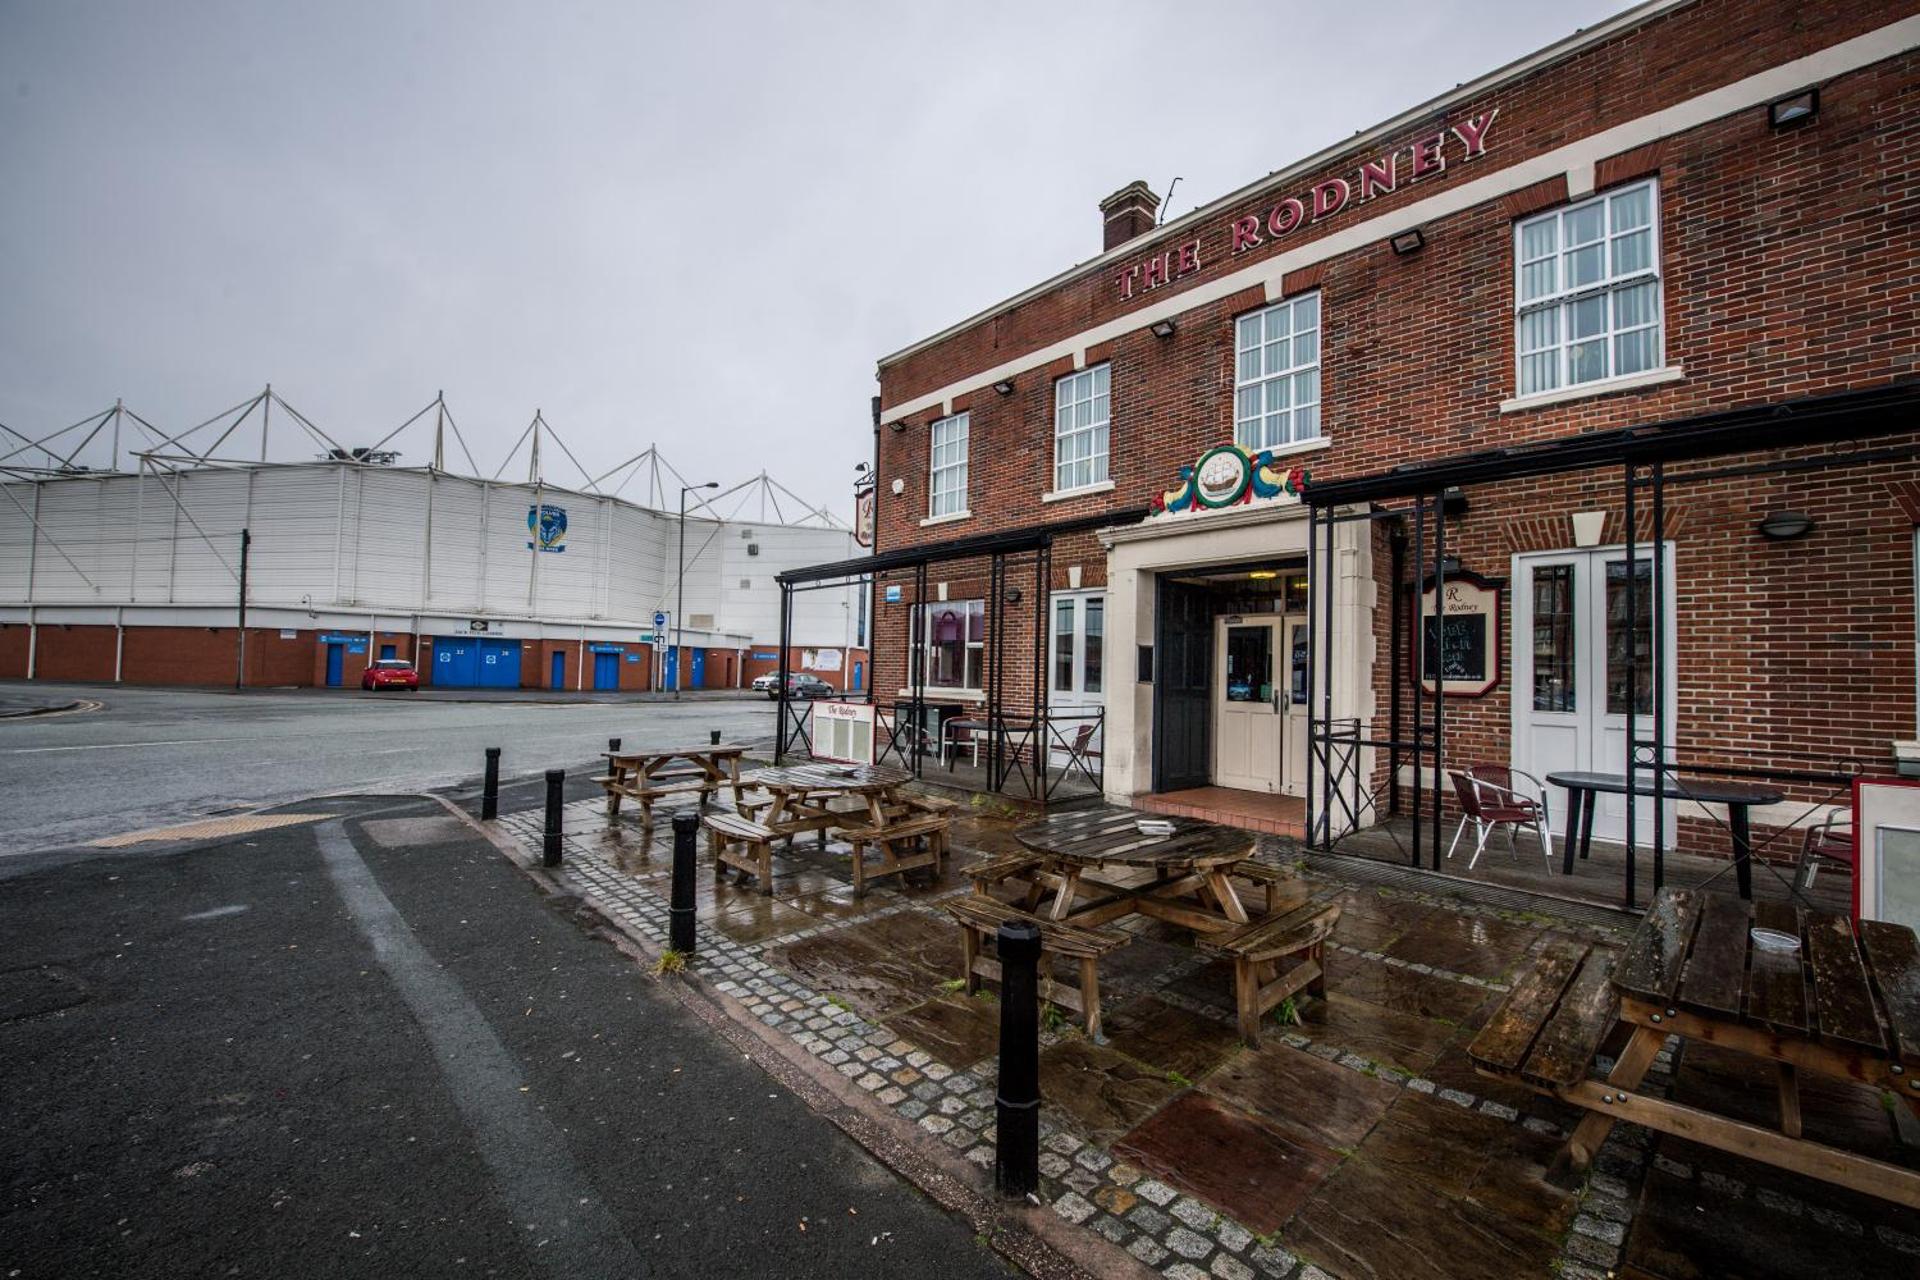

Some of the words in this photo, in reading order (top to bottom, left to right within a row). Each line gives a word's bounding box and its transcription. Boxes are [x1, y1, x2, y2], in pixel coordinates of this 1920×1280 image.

[1115, 239, 1200, 300] THE
[1231, 108, 1499, 255] RODNEY
[1446, 588, 1462, 601] R
[1449, 603, 1477, 612] Rodney
